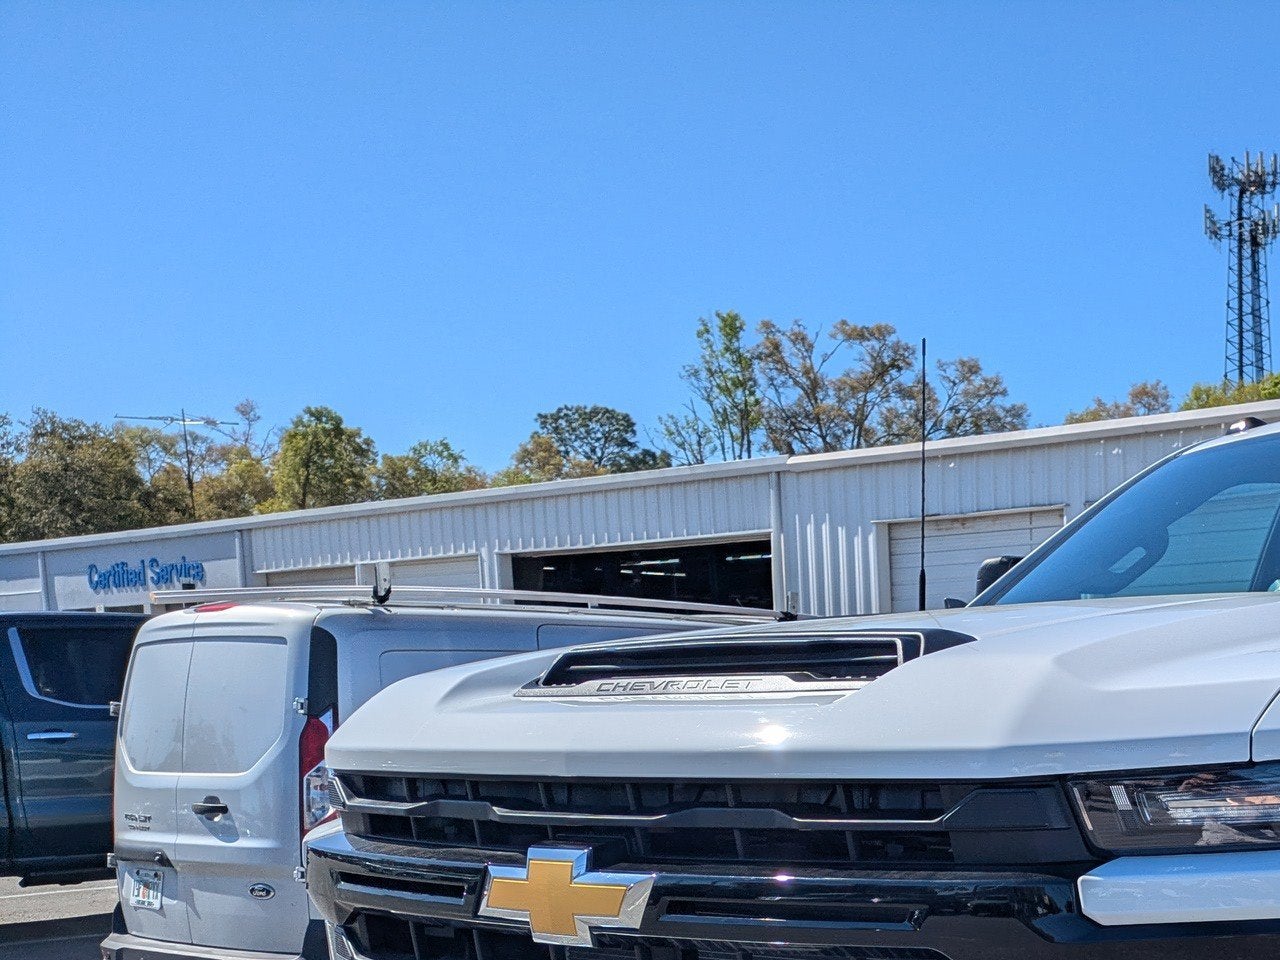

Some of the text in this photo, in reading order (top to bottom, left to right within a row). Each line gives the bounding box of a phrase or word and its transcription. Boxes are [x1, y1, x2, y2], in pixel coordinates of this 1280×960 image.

[87, 556, 204, 589] Certified Service
[595, 678, 762, 693] CHEVROLET
